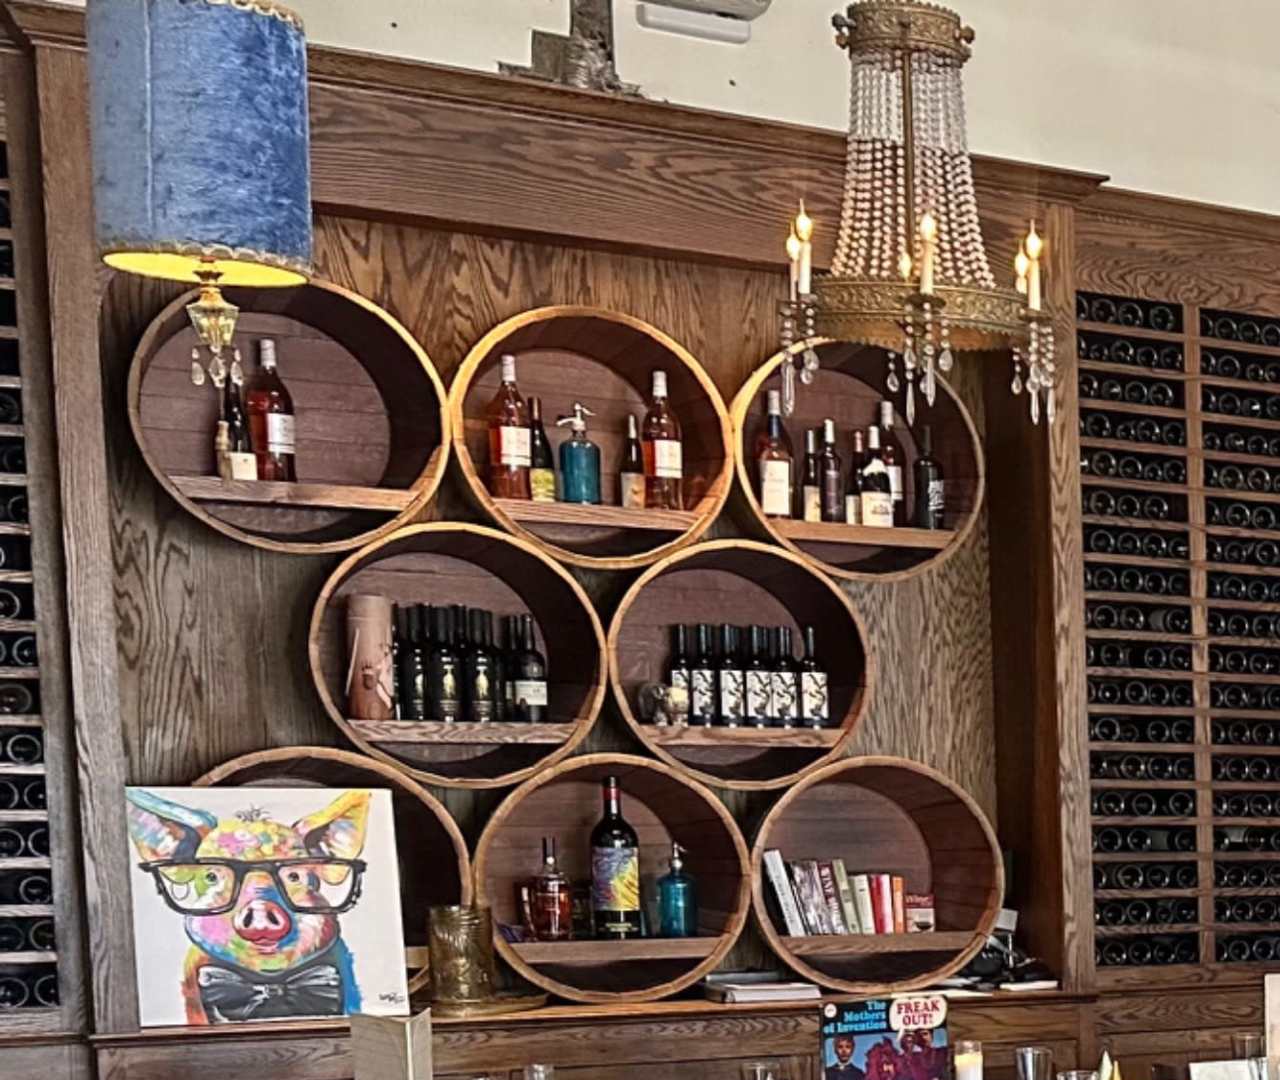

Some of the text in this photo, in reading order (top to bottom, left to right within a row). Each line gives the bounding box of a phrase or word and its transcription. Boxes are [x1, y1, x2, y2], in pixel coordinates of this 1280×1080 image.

[866, 1001, 887, 1011] The
[896, 1000, 940, 1014] FREAK
[844, 1011, 887, 1023] Mothers
[902, 1014, 934, 1026] OUT!
[824, 1020, 887, 1034] of Invention
